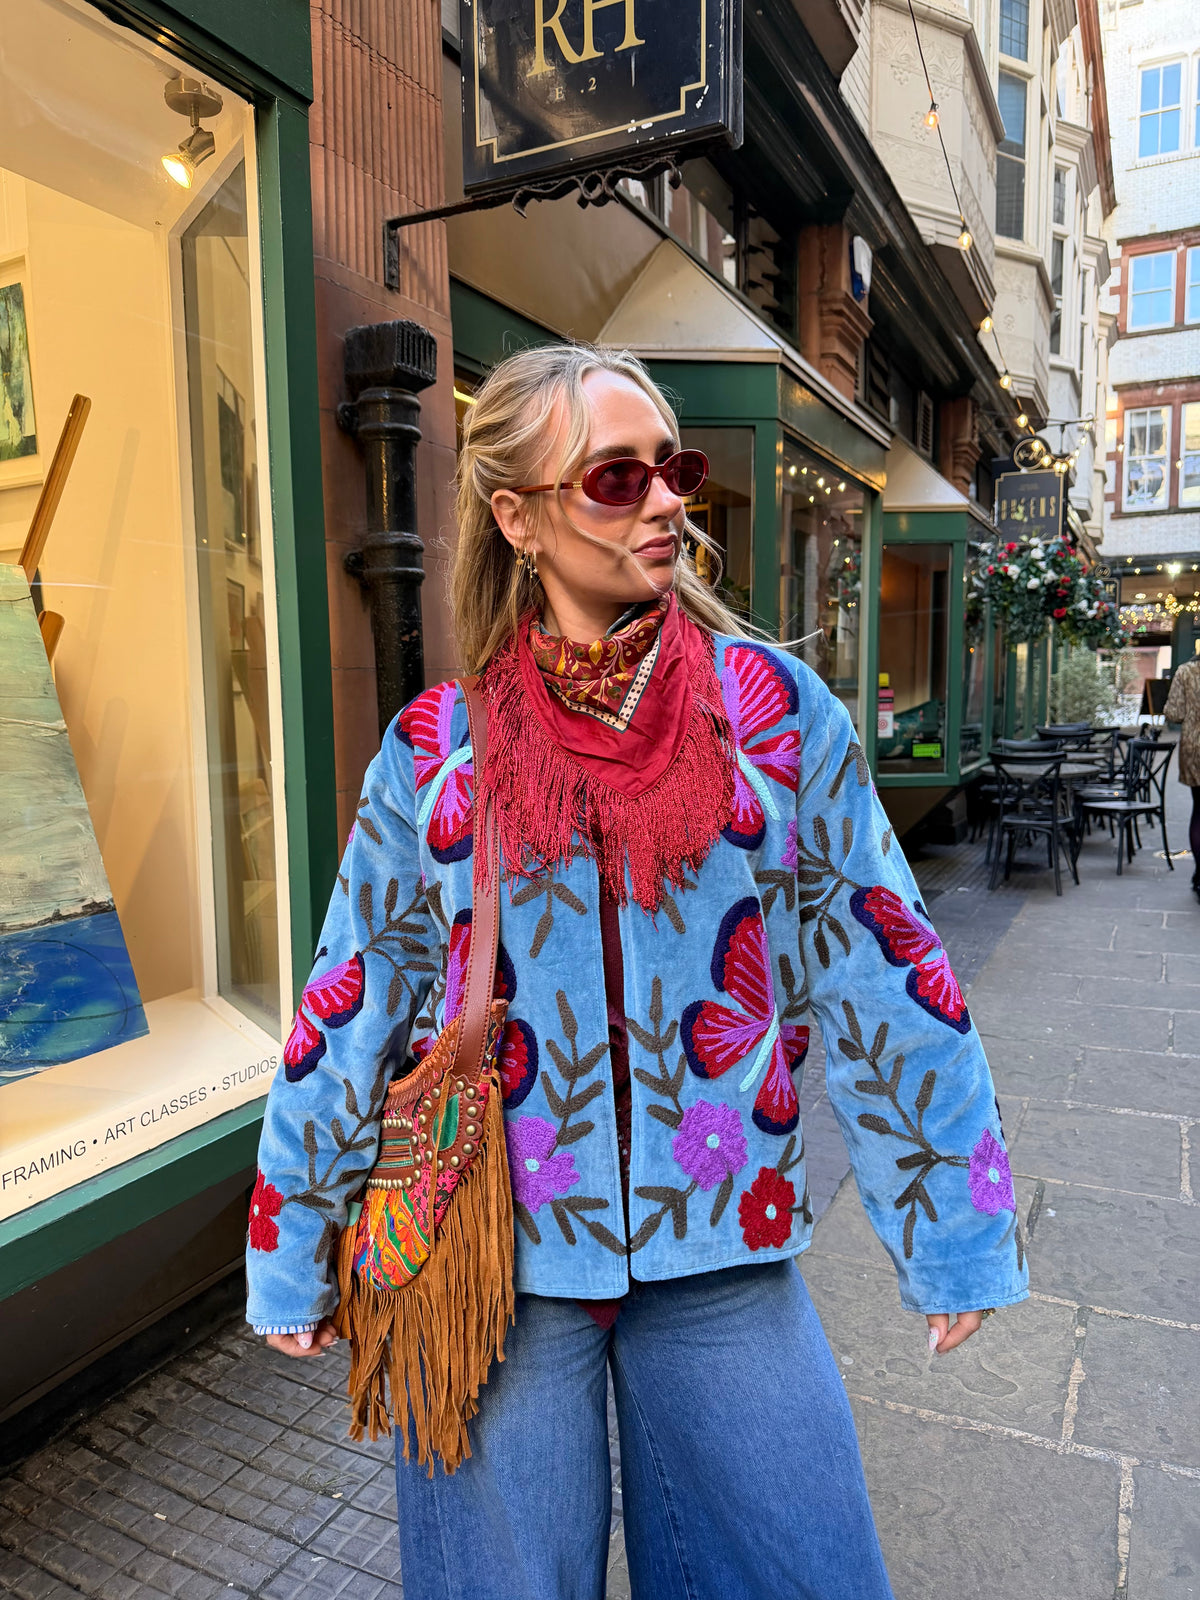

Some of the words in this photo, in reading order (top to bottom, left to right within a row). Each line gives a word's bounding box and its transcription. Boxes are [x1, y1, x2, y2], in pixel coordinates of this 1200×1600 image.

[1, 1140, 87, 1190] FRAMING
[104, 1117, 136, 1145] ART
[140, 1086, 207, 1127] CLASSES
[222, 1055, 278, 1092] STUDIOS
